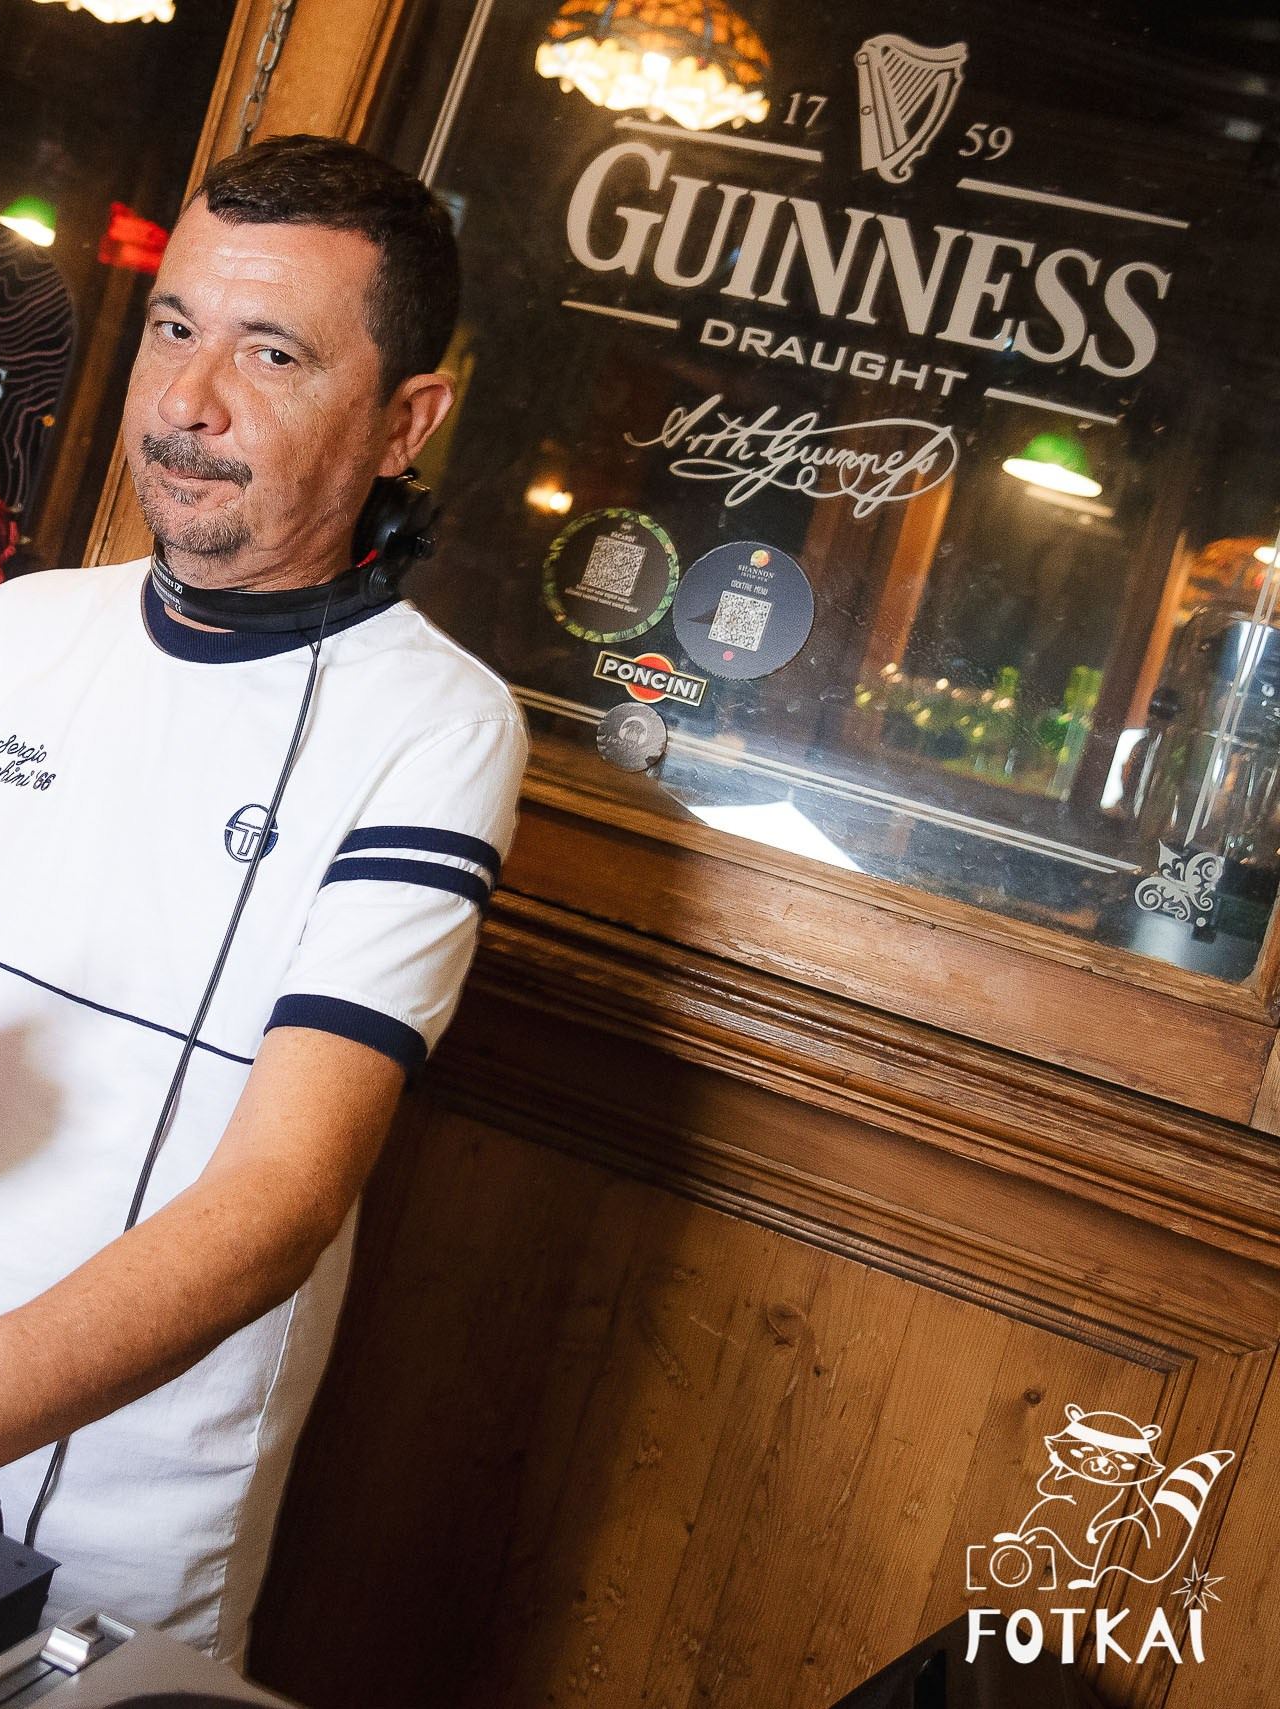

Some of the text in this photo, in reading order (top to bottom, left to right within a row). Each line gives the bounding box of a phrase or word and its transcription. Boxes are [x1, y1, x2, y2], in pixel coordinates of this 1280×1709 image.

[783, 91, 827, 128] 17
[958, 122, 1014, 161] 59
[566, 141, 1171, 378] GUINNESS
[700, 317, 968, 397] DRAUGHT
[602, 658, 699, 699] PONCINI
